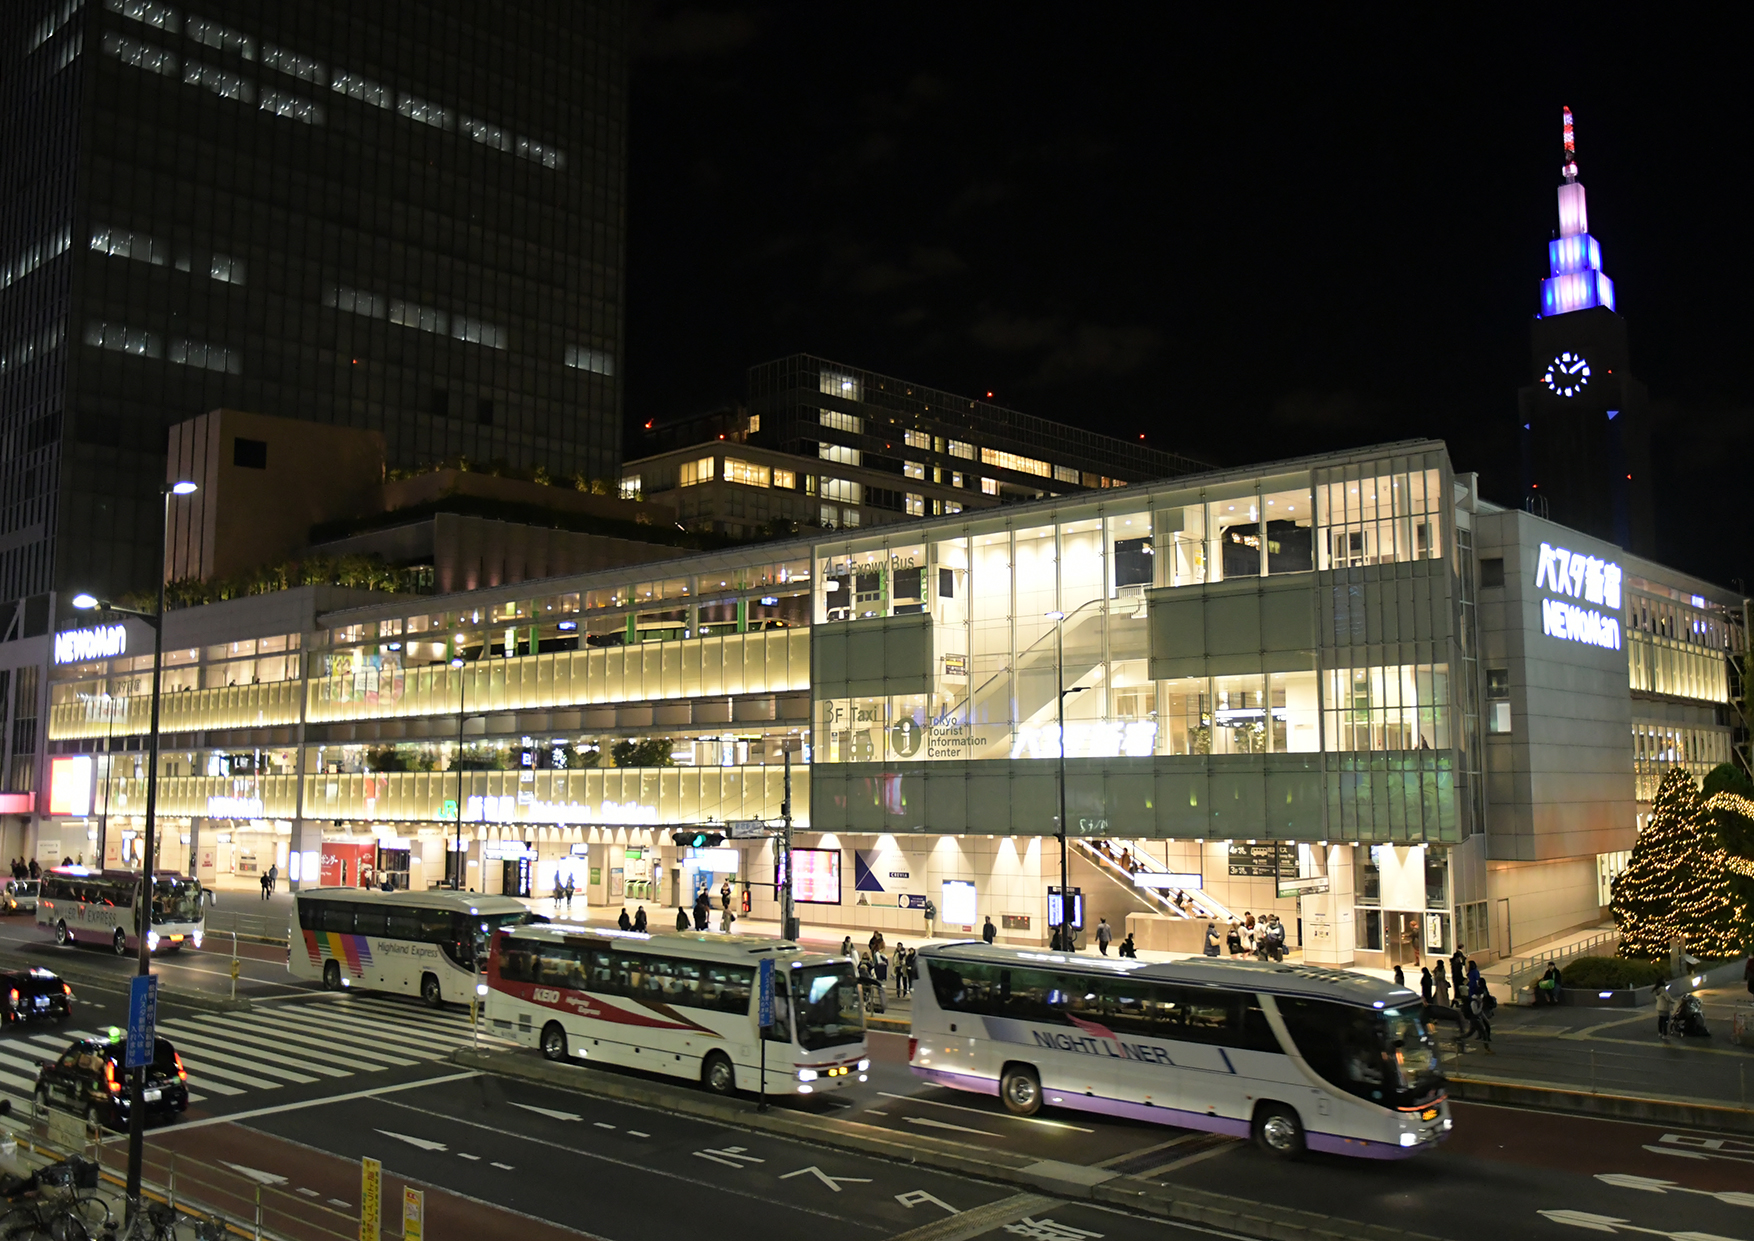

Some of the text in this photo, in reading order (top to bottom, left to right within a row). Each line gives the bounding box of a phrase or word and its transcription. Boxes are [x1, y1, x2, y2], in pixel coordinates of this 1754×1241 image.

[823, 555, 914, 579] 4F Expwy Bus
[1536, 542, 1622, 610] バスタ新宿
[824, 700, 877, 723] 3F Taxi
[928, 716, 957, 729] Tokyo
[928, 726, 962, 737] Tourist
[928, 737, 987, 747] Information
[928, 748, 960, 758] Center
[437, 800, 458, 819] JR
[87, 910, 116, 926] EXPRESS
[377, 941, 438, 958] Highland Express
[533, 988, 560, 1003] KEIO
[1032, 1030, 1099, 1055] NIGHT
